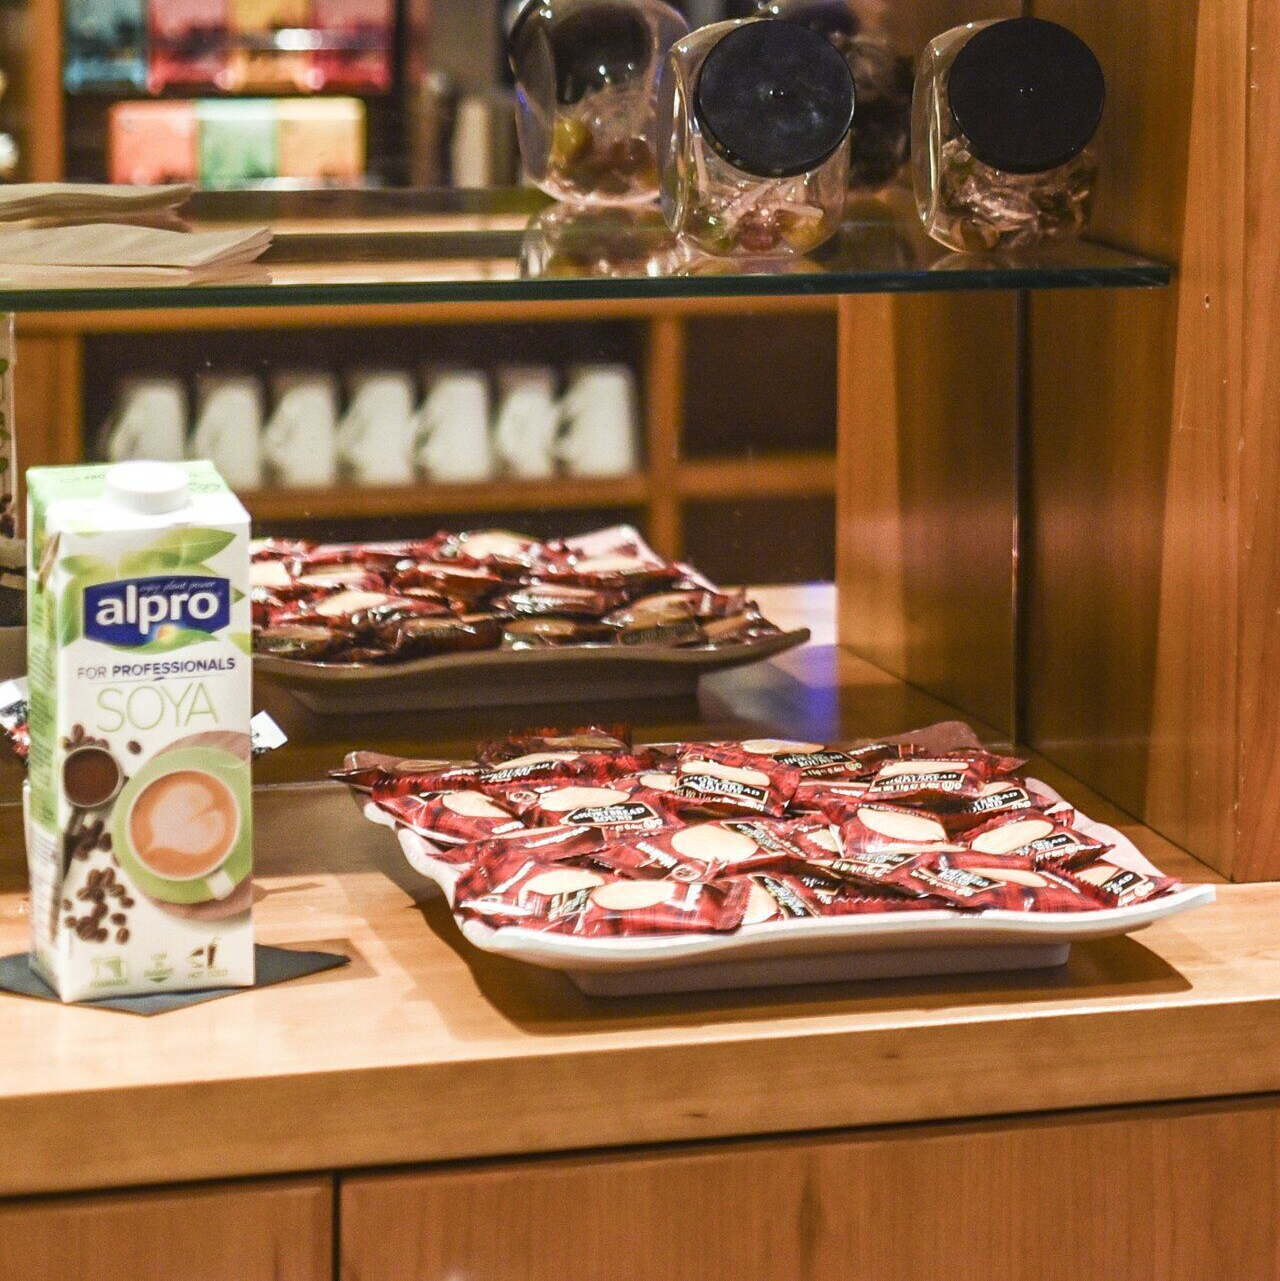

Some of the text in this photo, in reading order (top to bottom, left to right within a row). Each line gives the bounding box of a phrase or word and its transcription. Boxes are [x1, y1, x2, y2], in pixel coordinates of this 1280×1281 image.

[140, 580, 216, 593] enjoy plant power
[96, 584, 219, 635] alpro
[77, 657, 236, 680] FOR PROFESSIONALS
[96, 682, 219, 733] SOYA
